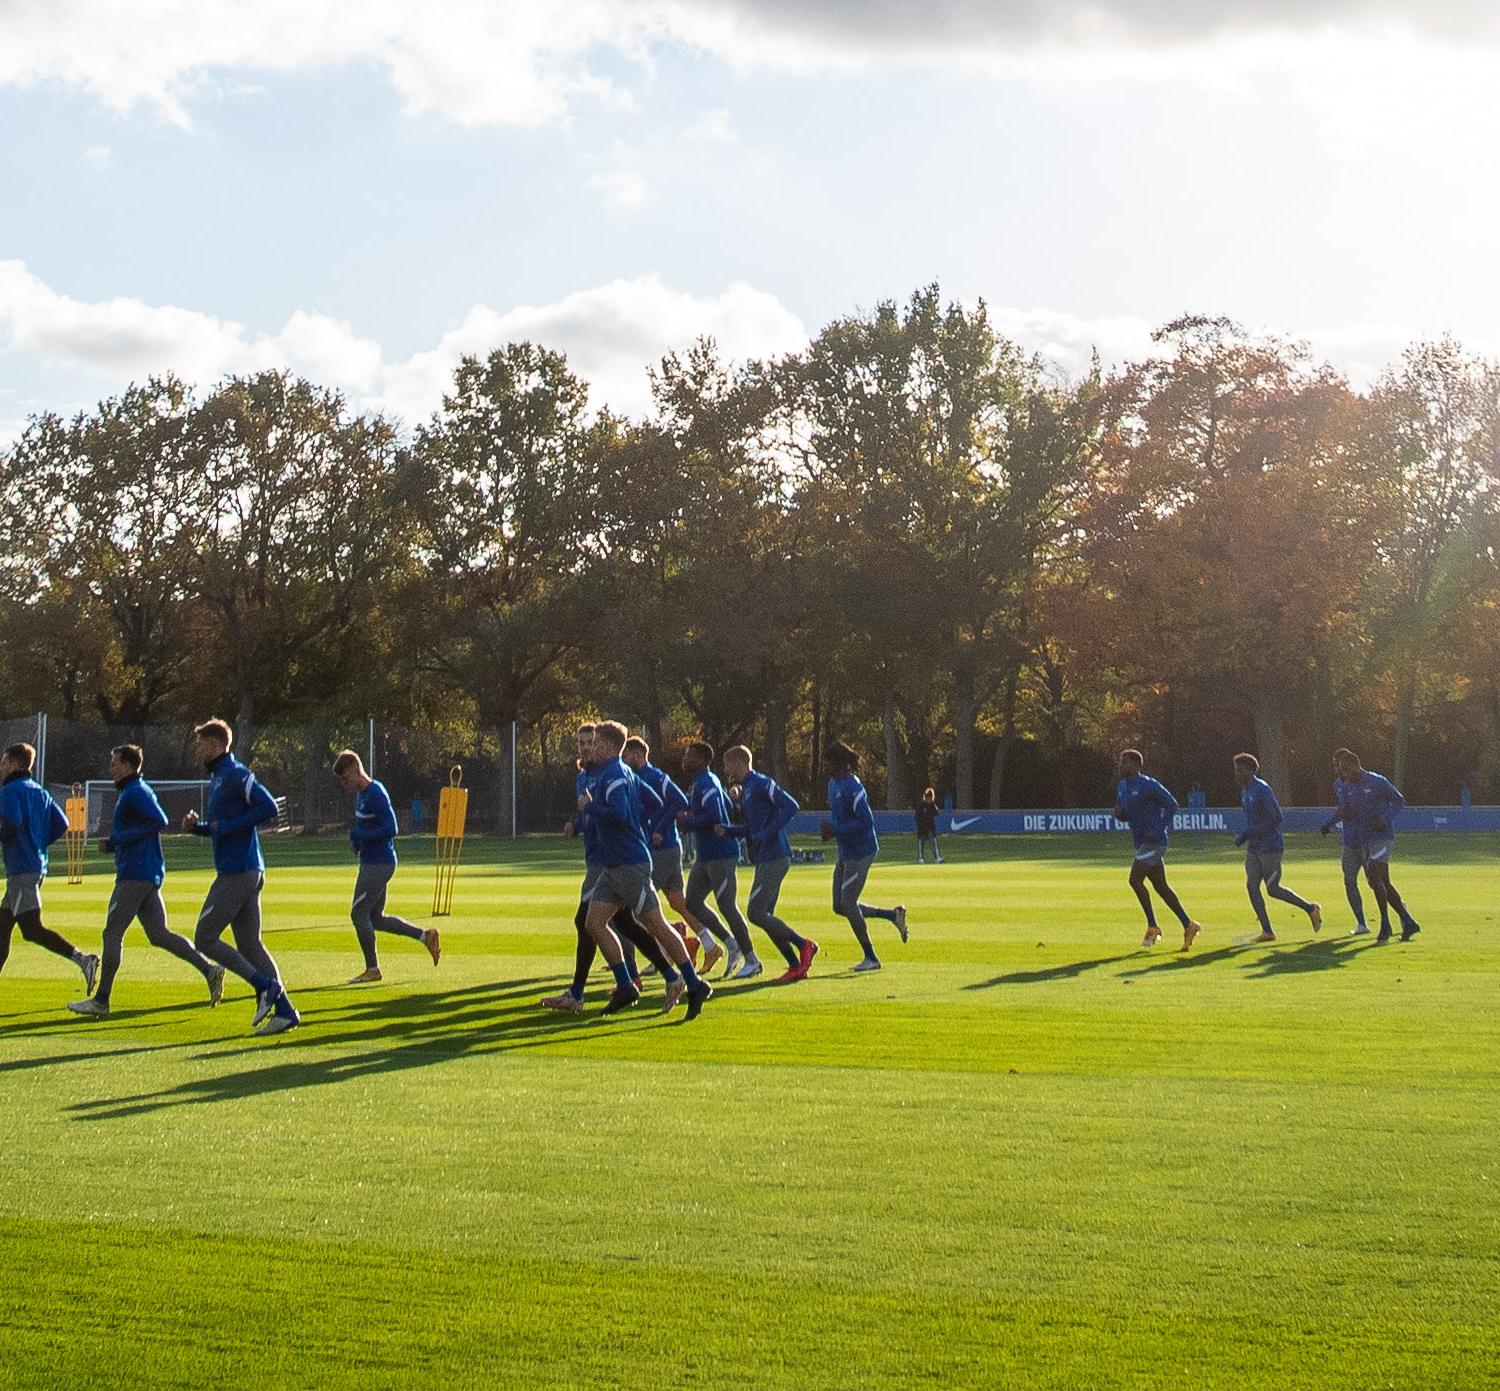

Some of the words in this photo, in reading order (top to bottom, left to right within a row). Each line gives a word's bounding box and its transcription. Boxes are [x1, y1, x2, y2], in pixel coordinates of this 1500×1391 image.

[1023, 814, 1046, 830] DIE
[1049, 814, 1111, 830] ZUKUNFT
[1172, 813, 1227, 830] BERLIN.
